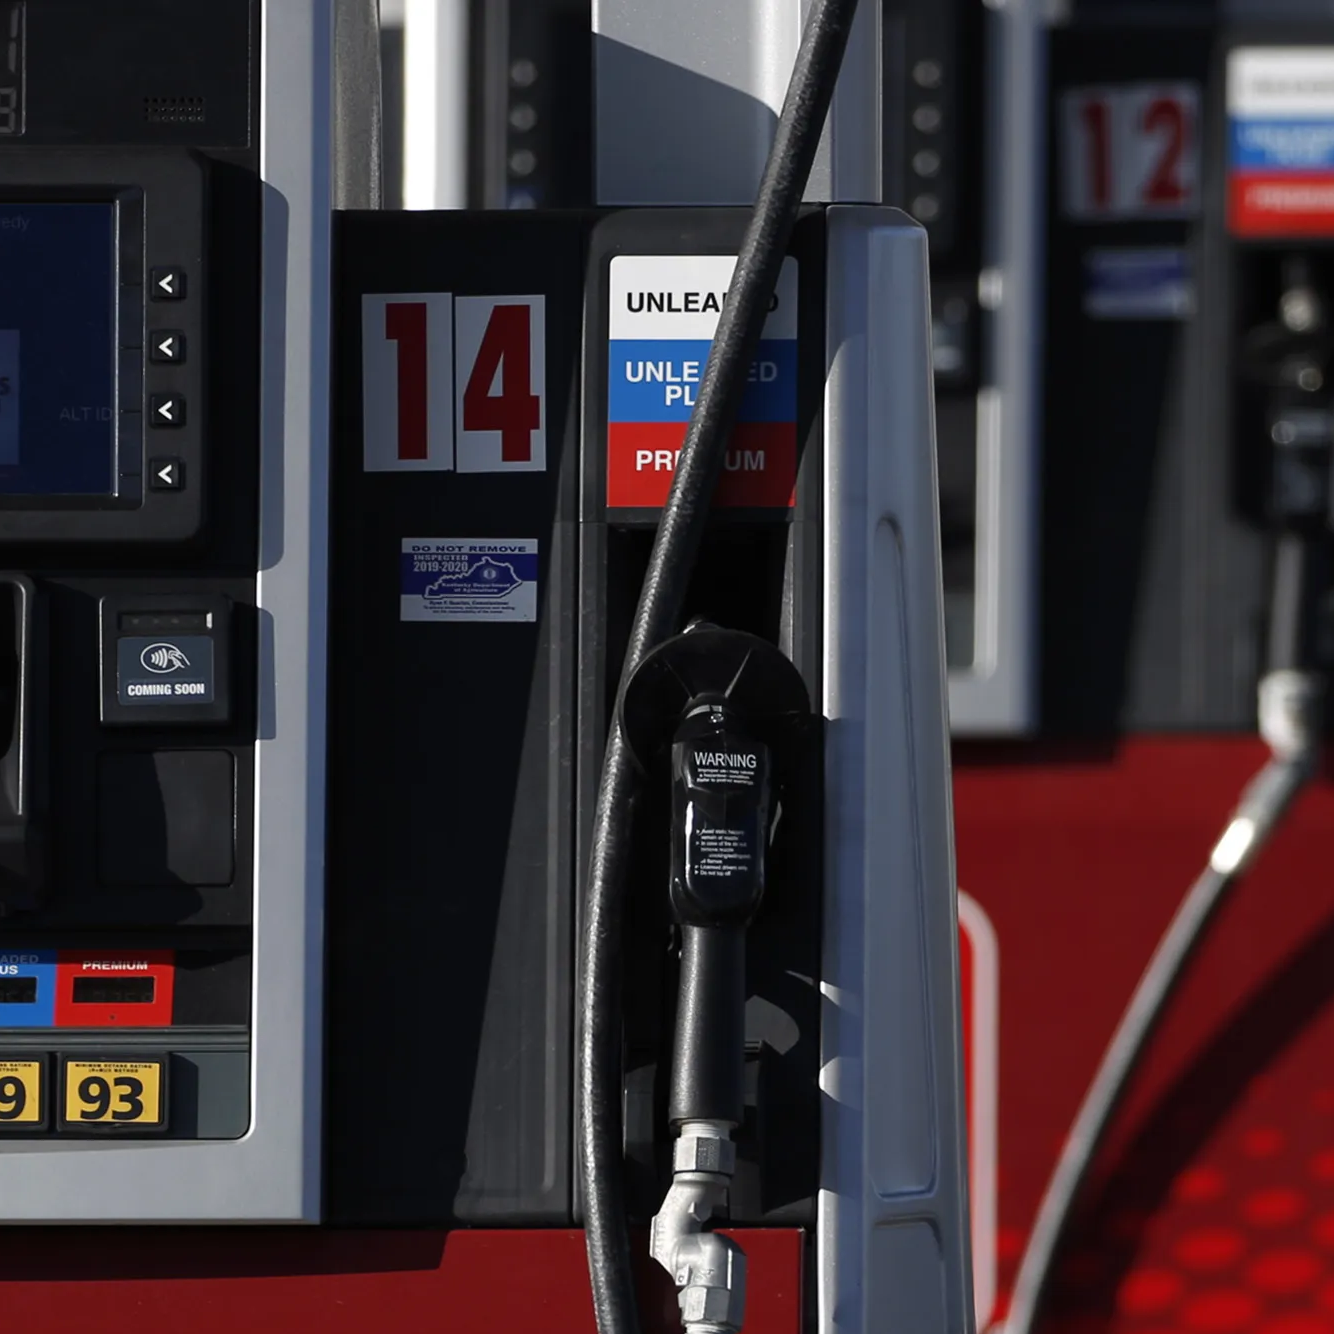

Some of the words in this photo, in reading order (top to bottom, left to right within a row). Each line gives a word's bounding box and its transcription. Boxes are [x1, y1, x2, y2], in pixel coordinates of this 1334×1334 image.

[1082, 94, 1189, 208] 12
[384, 302, 541, 462] 14
[625, 361, 779, 384] UNLEED
[127, 682, 171, 696] COMING
[175, 682, 205, 696] SOON
[694, 752, 757, 769] WARNING
[82, 960, 148, 970] PREMIUM
[78, 1076, 144, 1120] 93
